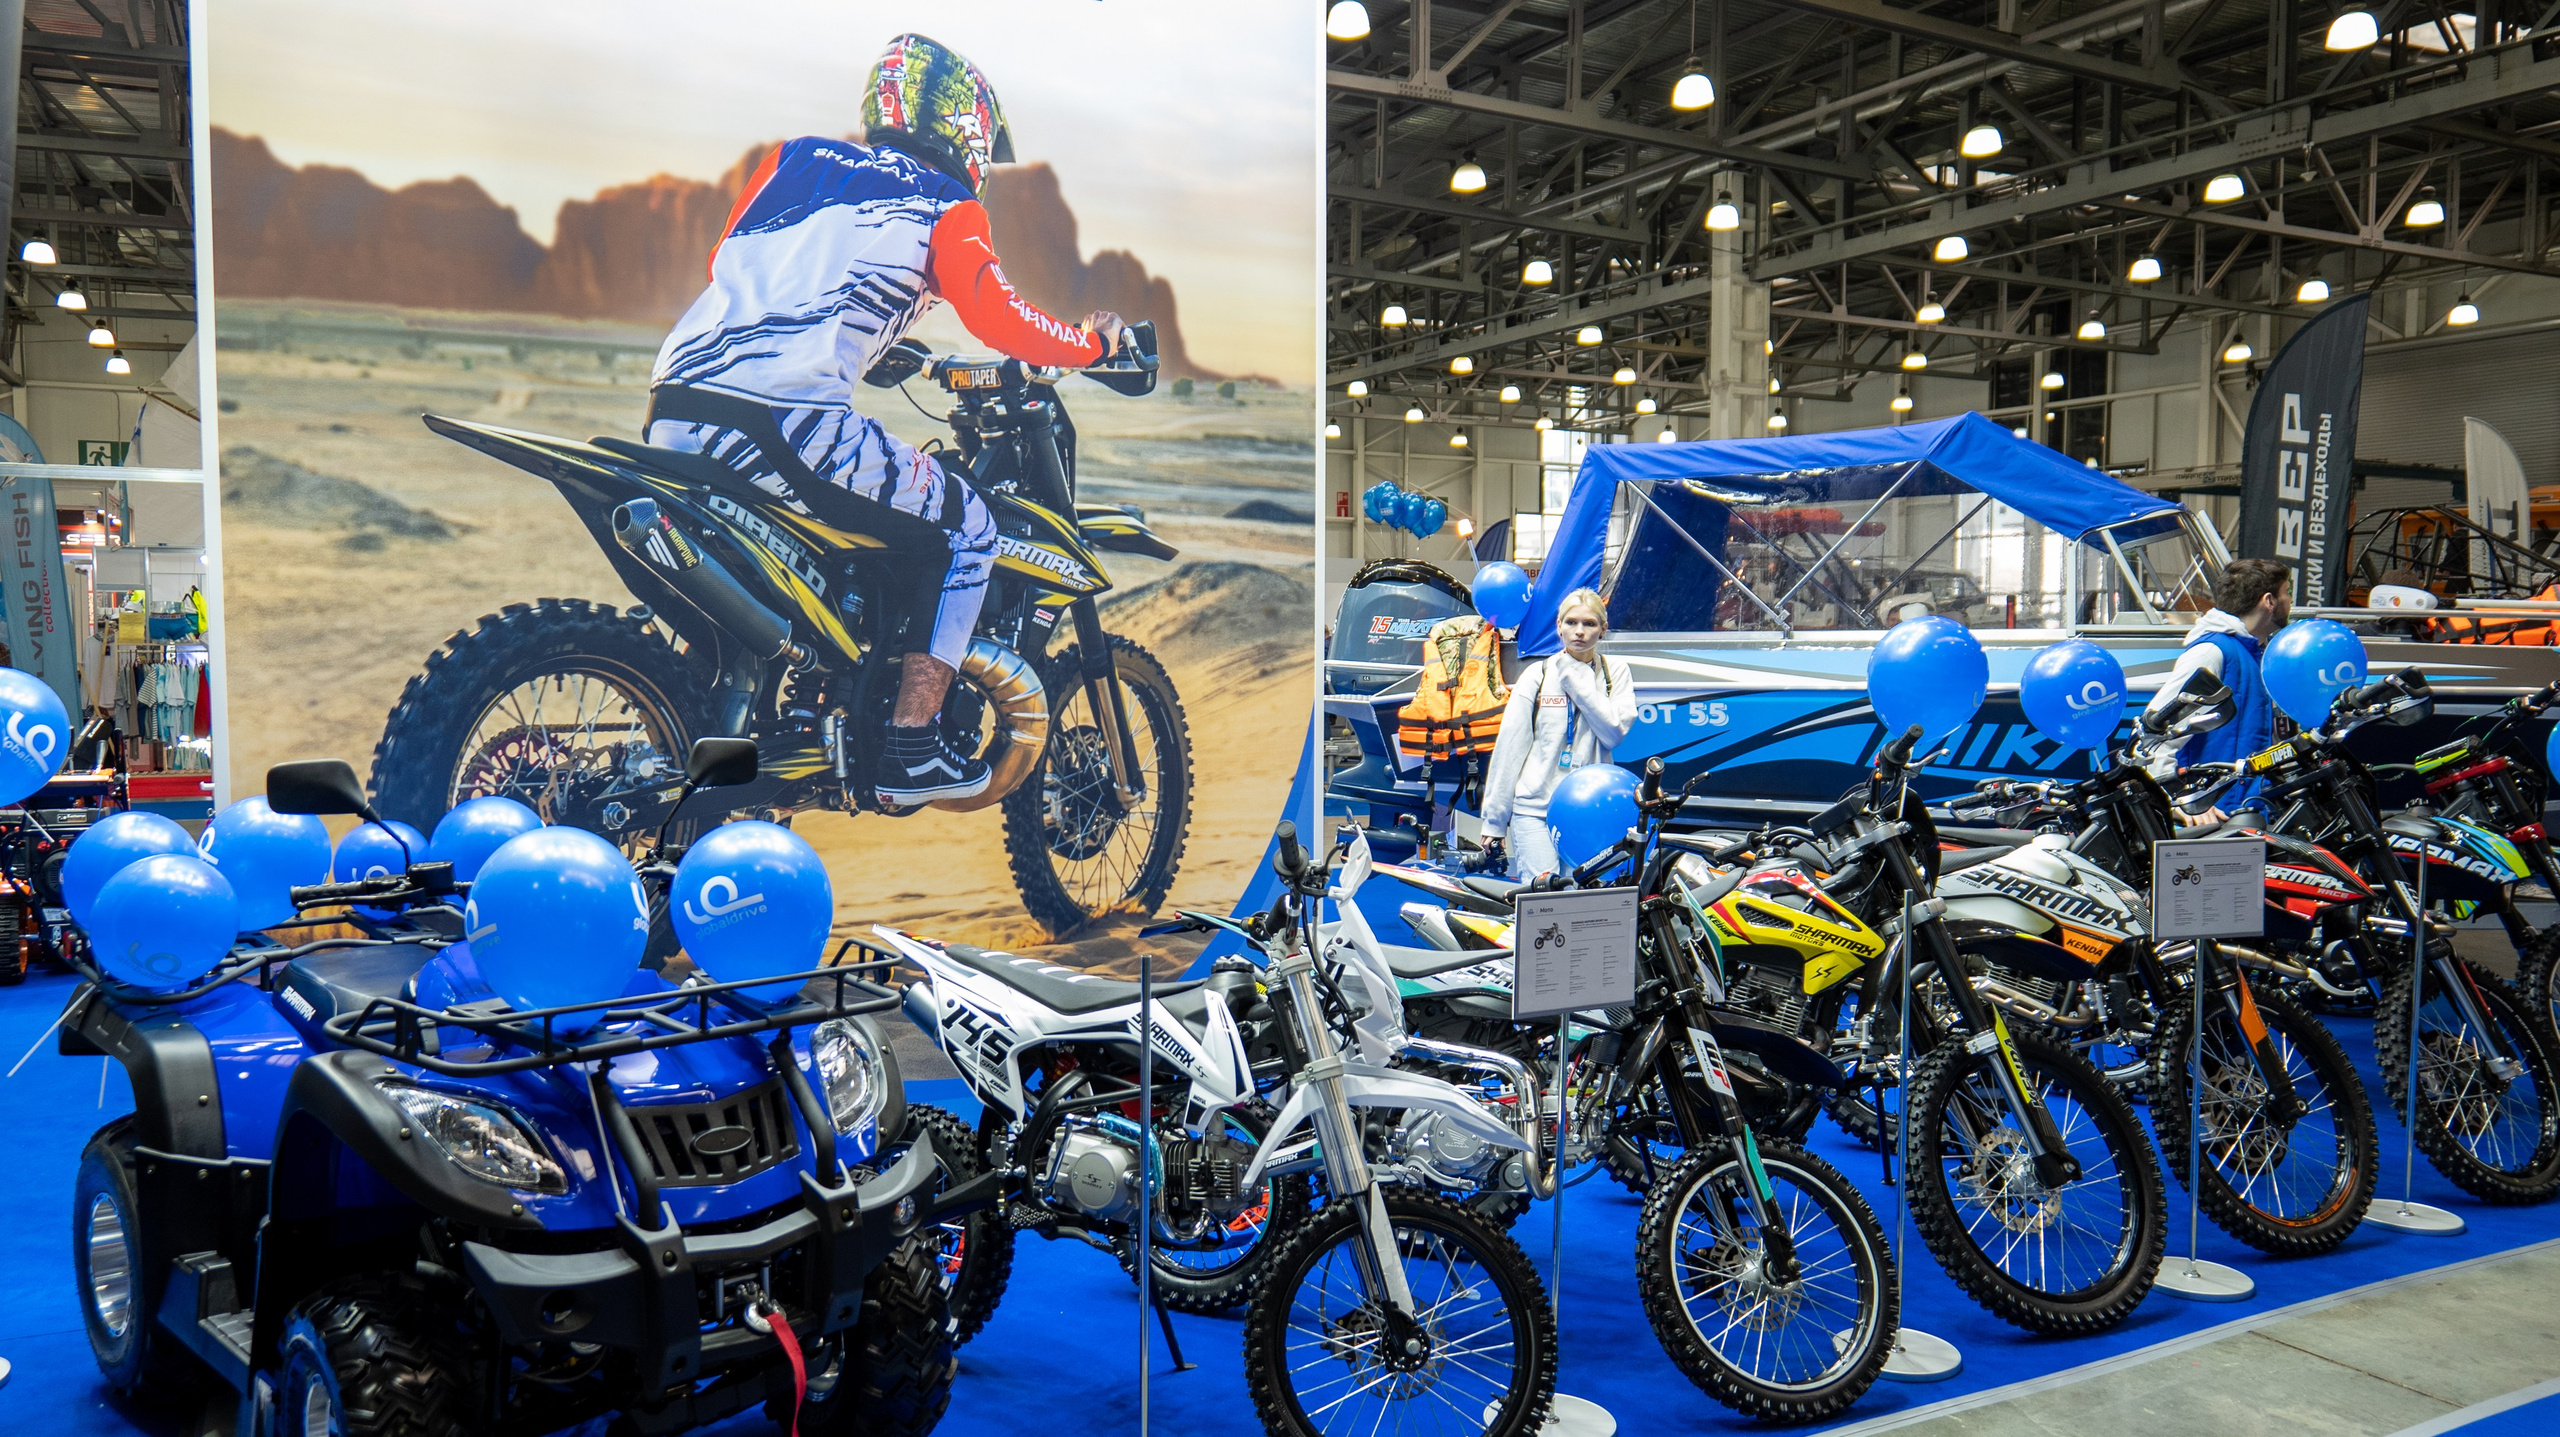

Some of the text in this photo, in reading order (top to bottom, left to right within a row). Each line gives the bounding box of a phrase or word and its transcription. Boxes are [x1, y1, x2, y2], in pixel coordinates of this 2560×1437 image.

[950, 367, 998, 389] PROTAPER
[2215, 473, 2242, 482] TRAVE
[2309, 413, 2332, 536] ВЕЗДЕХОДЫ
[2276, 393, 2310, 607] ВЕР
[12, 492, 35, 568] FISH
[996, 534, 1097, 588] ARMAX
[1541, 697, 1567, 705] NASA
[1688, 702, 1730, 727] 55
[2254, 745, 2296, 768] PROTAPER
[1960, 867, 2133, 931] SHARMAX
[2317, 888, 2350, 900] RACE
[1789, 932, 1826, 948] MOTORS
[1794, 923, 1877, 957] SHARMAX
[2066, 938, 2104, 957] KENDA
[281, 985, 317, 1021] SHARMAX
[1131, 1012, 1196, 1069] SARMAX
